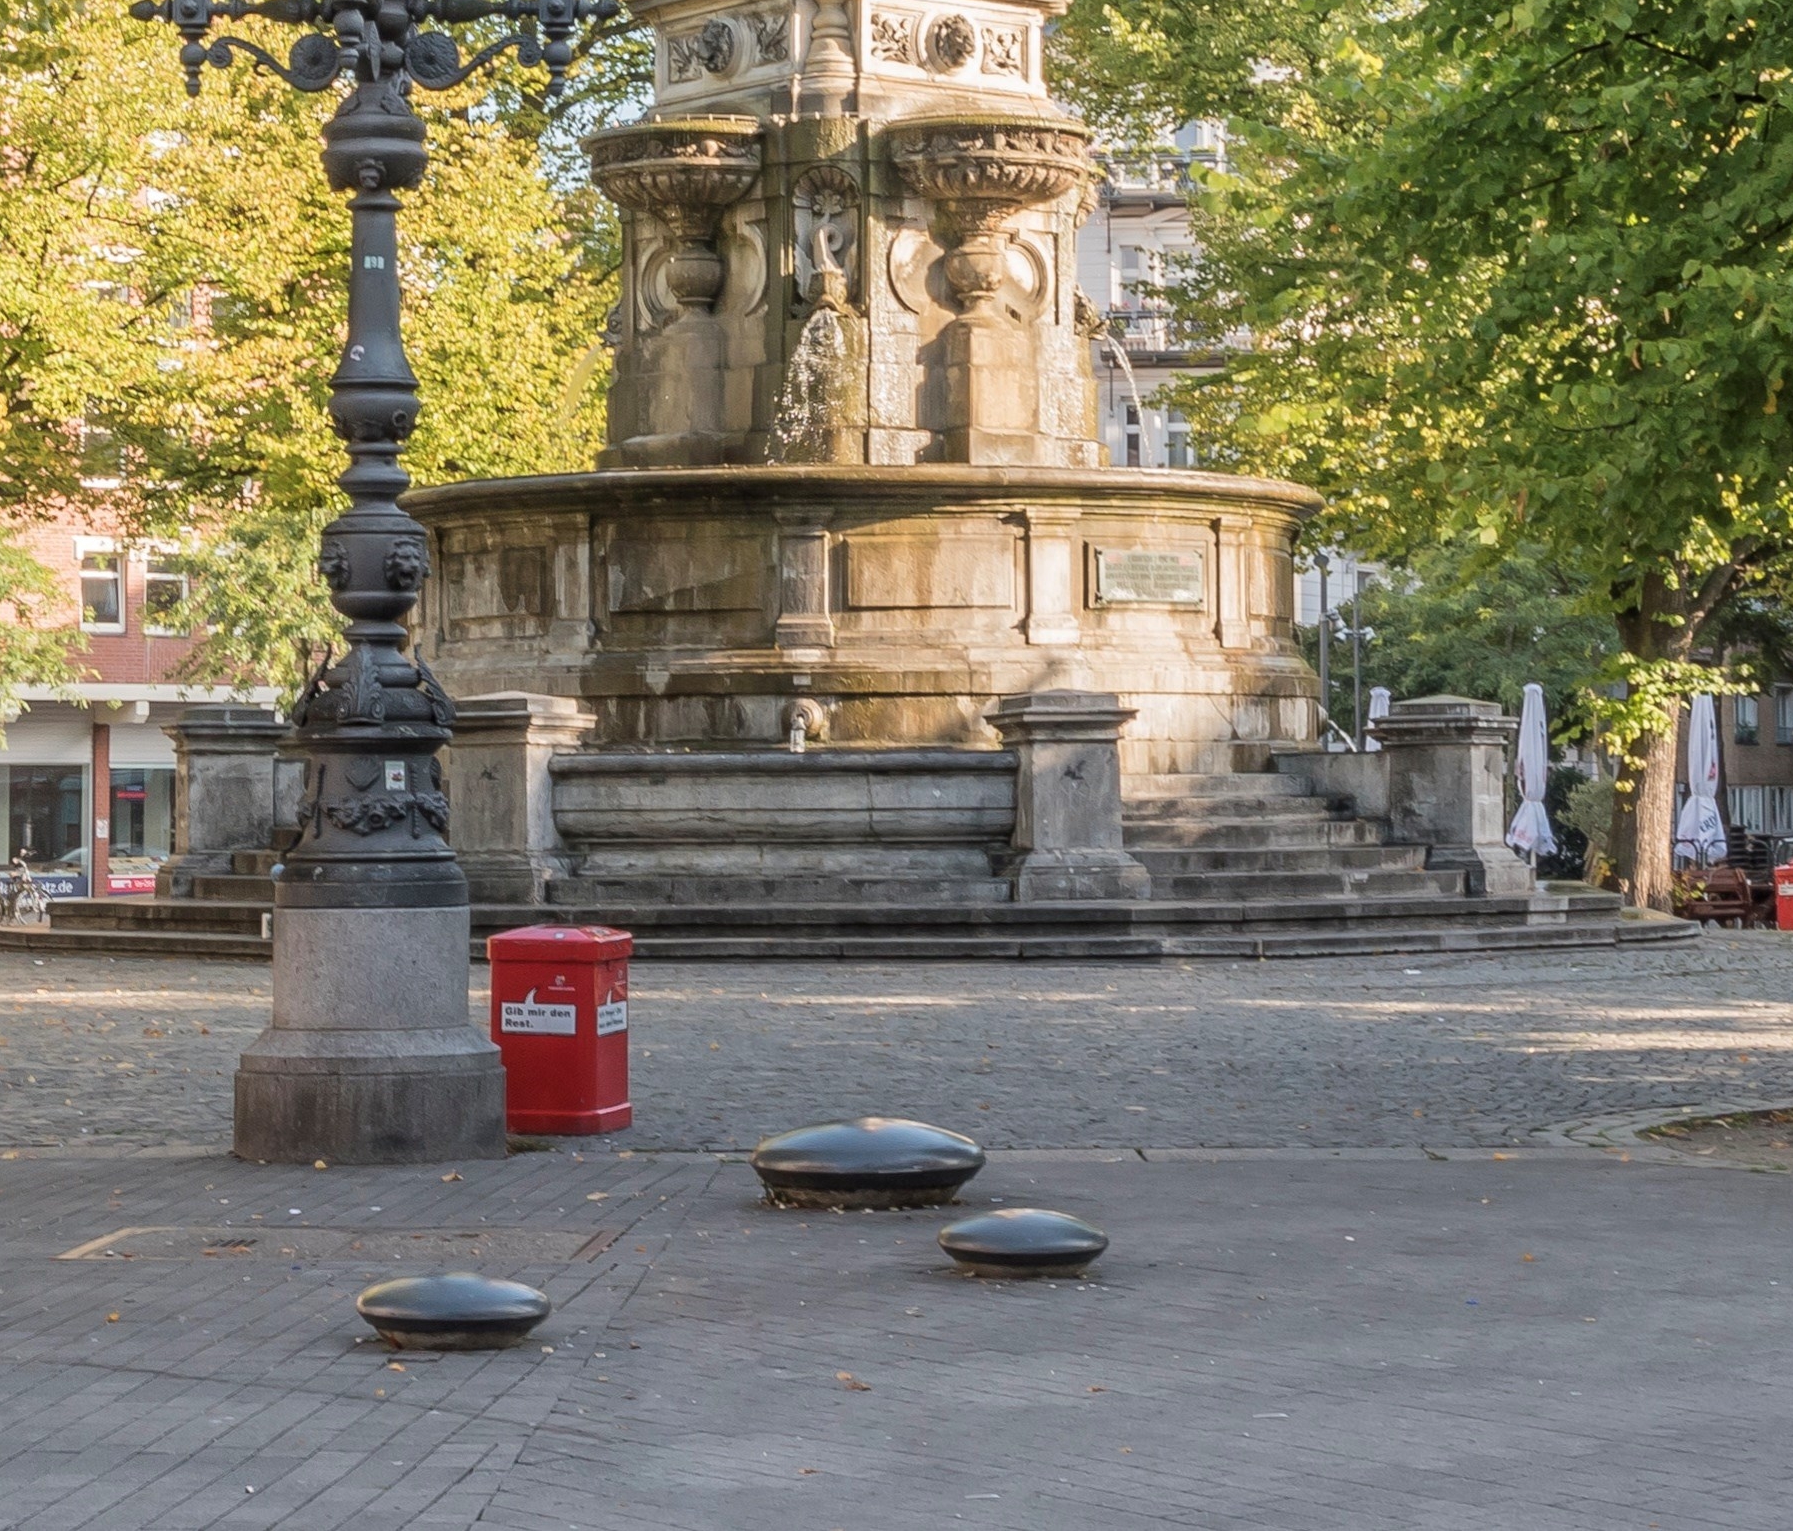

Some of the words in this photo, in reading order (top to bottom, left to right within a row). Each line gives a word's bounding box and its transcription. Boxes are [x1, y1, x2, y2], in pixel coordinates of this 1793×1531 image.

[505, 1006, 524, 1017] Gib
[528, 1008, 547, 1018] mir
[550, 1009, 572, 1018] den
[505, 1018, 534, 1029] Rest.
